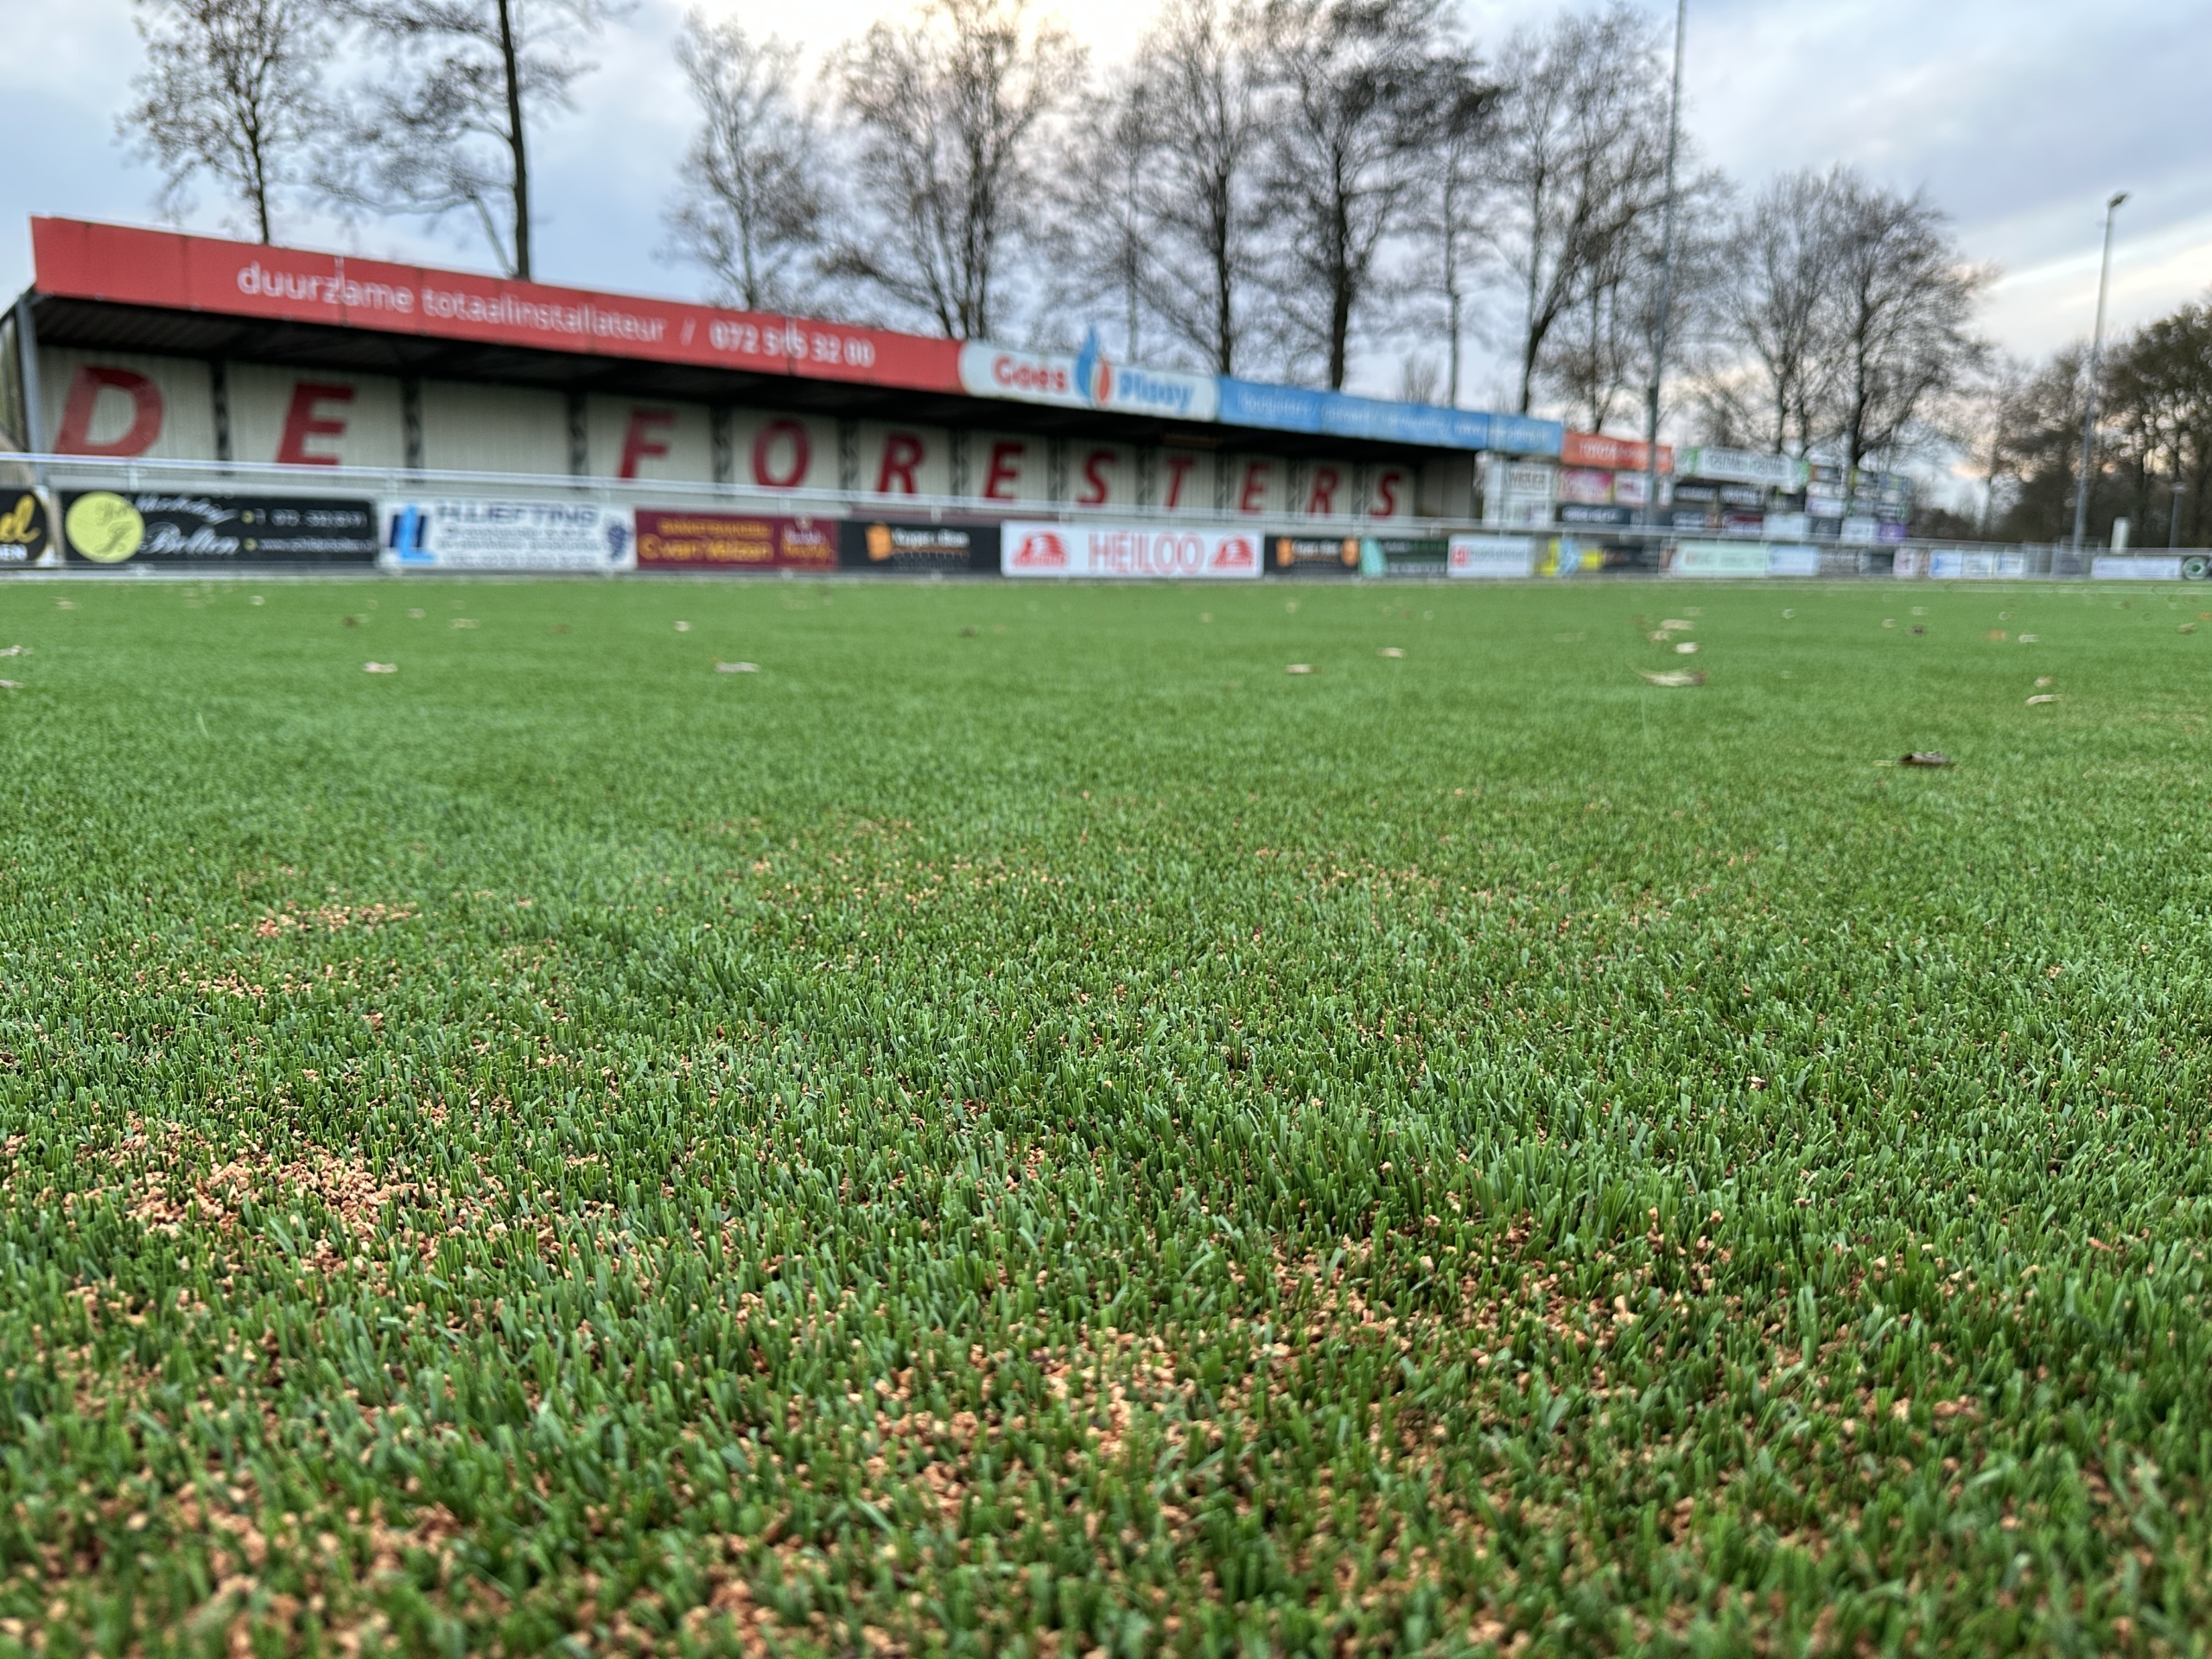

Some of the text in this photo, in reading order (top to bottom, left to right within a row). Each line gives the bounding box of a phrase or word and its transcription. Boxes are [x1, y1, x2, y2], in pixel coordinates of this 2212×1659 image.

[237, 261, 414, 313] duurzame
[422, 286, 666, 342] totaalinstallateur
[709, 319, 758, 354] 072
[810, 333, 842, 365] 32
[1087, 531, 1205, 574] HEILOO
